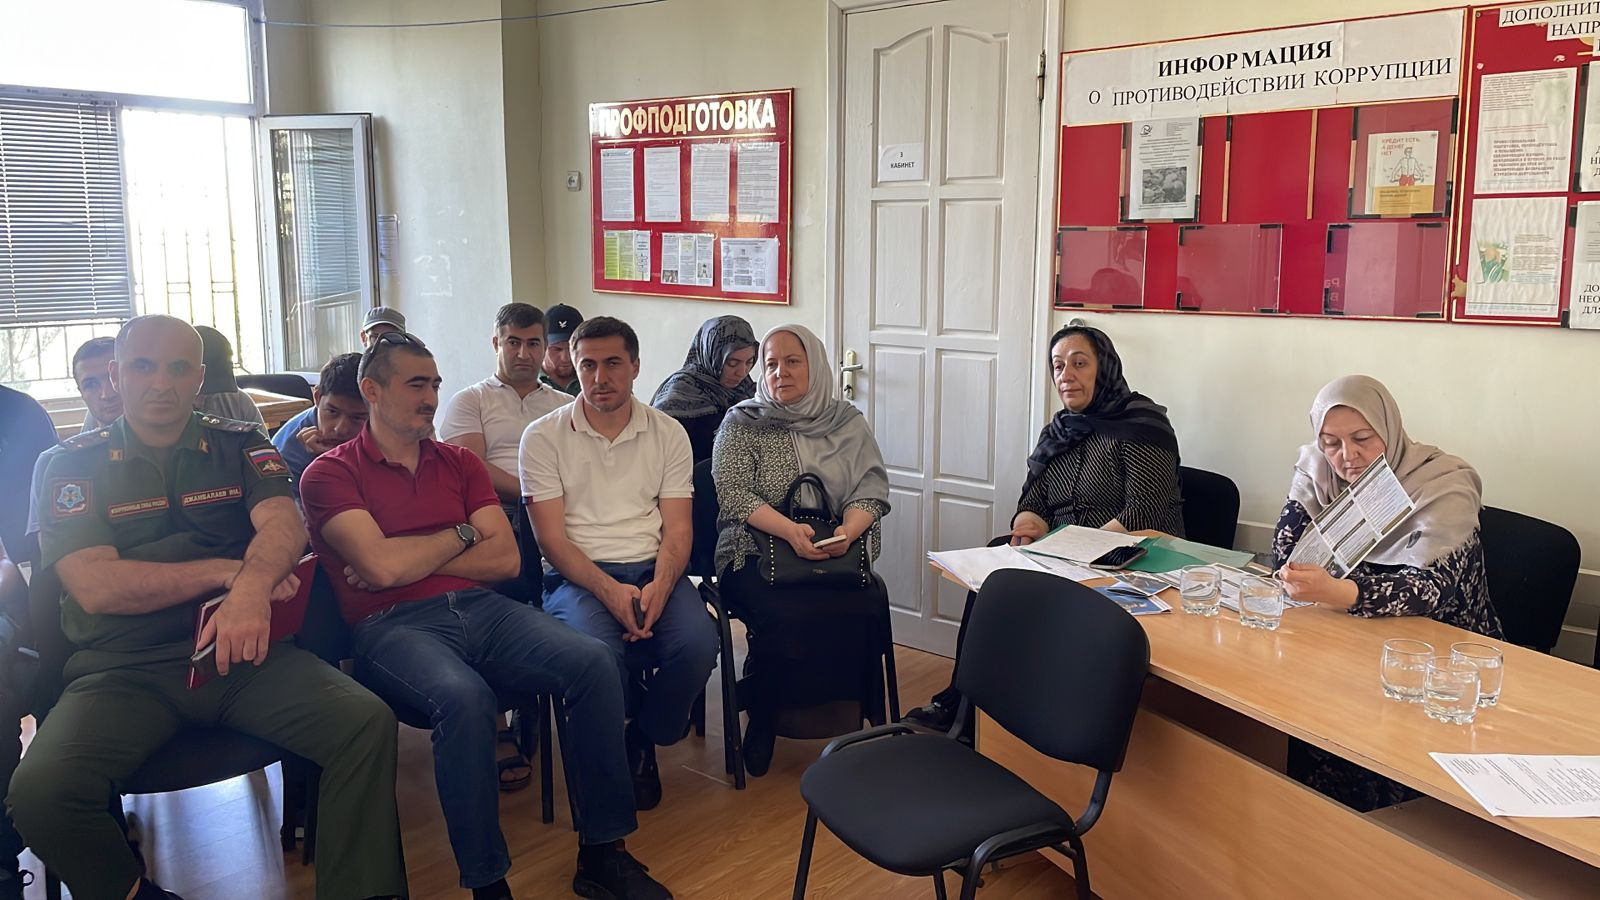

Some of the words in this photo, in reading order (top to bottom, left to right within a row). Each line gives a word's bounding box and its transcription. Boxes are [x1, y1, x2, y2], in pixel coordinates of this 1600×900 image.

[1502, 2, 1600, 25] ДОПОЛНИТ
[1552, 20, 1600, 36] НАПР
[1158, 40, 1333, 77] ИНФОРМАЦИЯ
[1089, 90, 1101, 104] О
[1113, 74, 1305, 106] ПРОТИВОДЕЙСТВИИ
[1314, 57, 1452, 87] КОРРУПЦИИ
[600, 98, 776, 137] ПРОФПОДГОТОВКА
